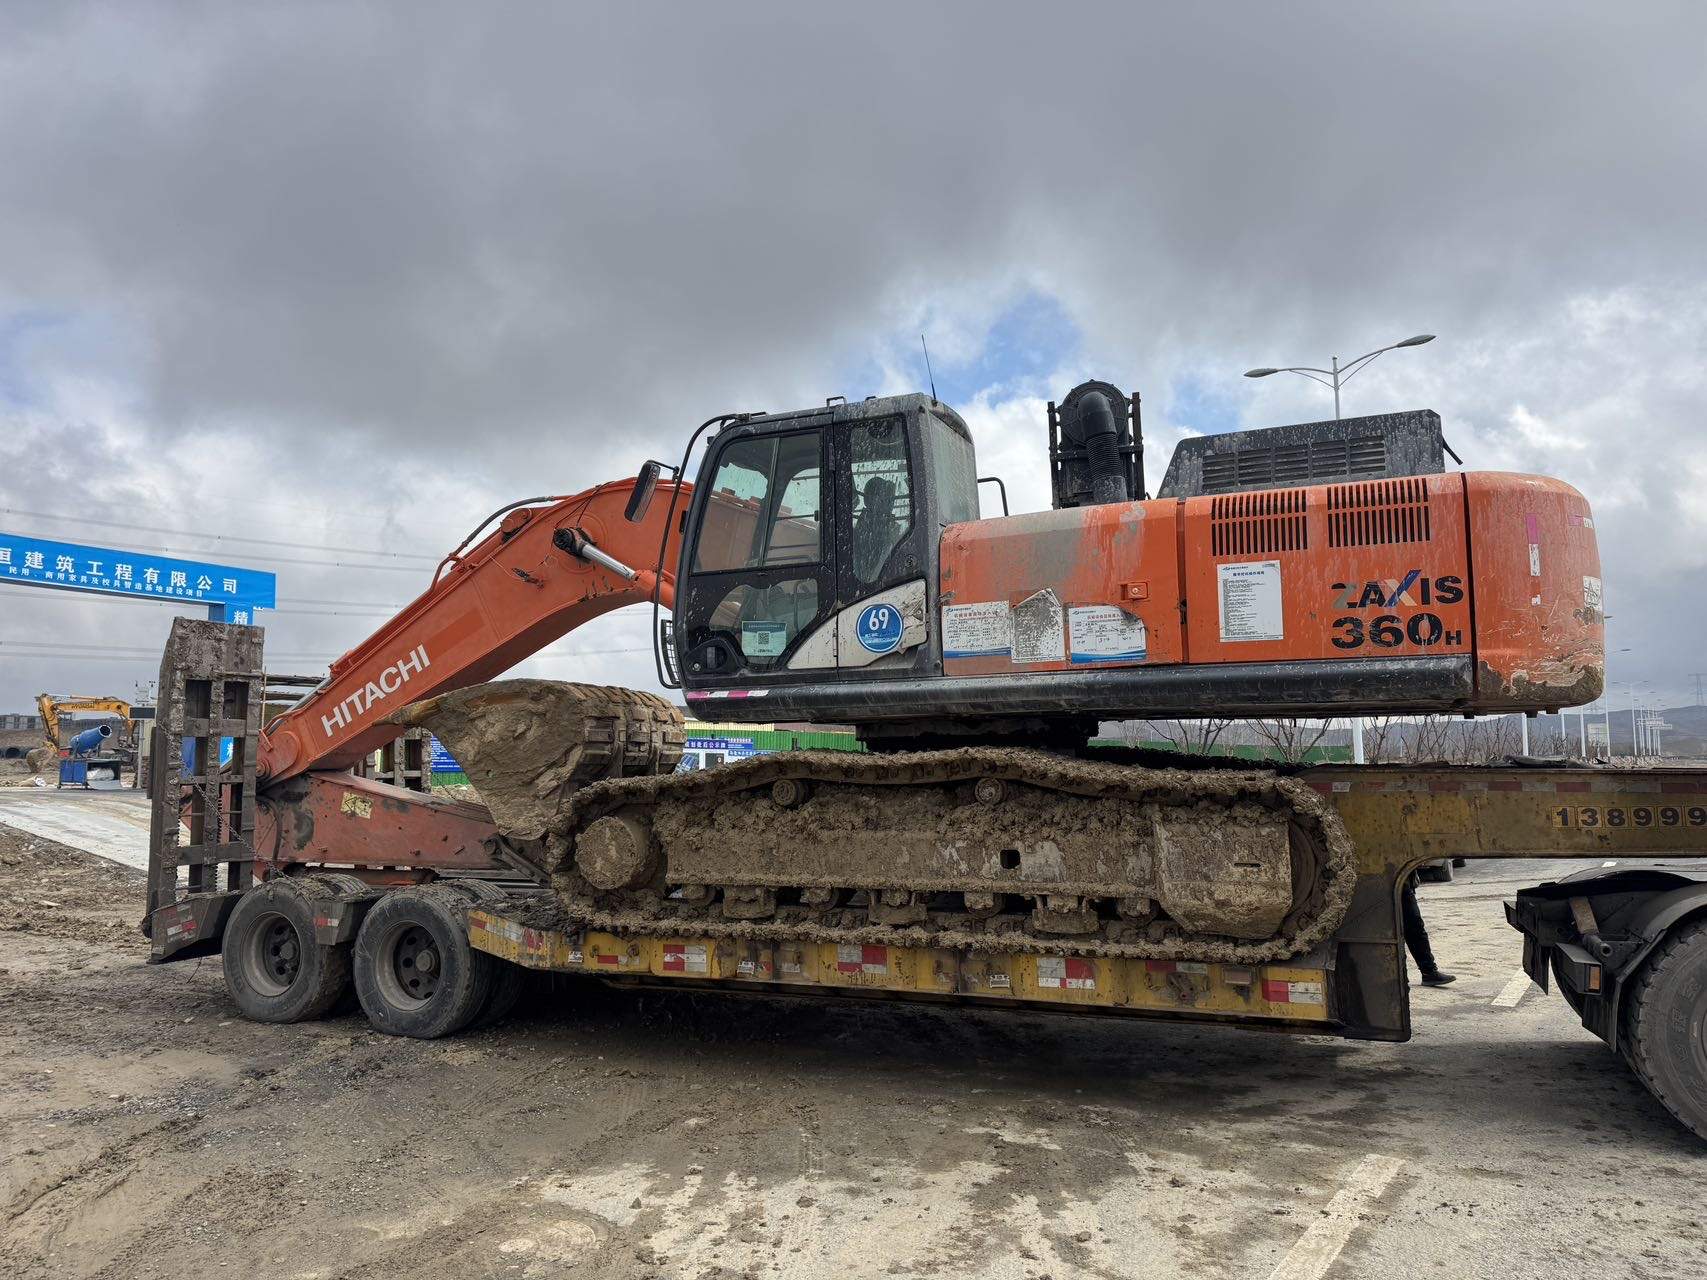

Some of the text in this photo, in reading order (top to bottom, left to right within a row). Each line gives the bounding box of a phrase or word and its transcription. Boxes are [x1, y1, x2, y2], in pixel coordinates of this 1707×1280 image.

[1330, 569, 1465, 609] ZAXIS
[868, 608, 889, 631] 69
[320, 644, 431, 739] HITACHI
